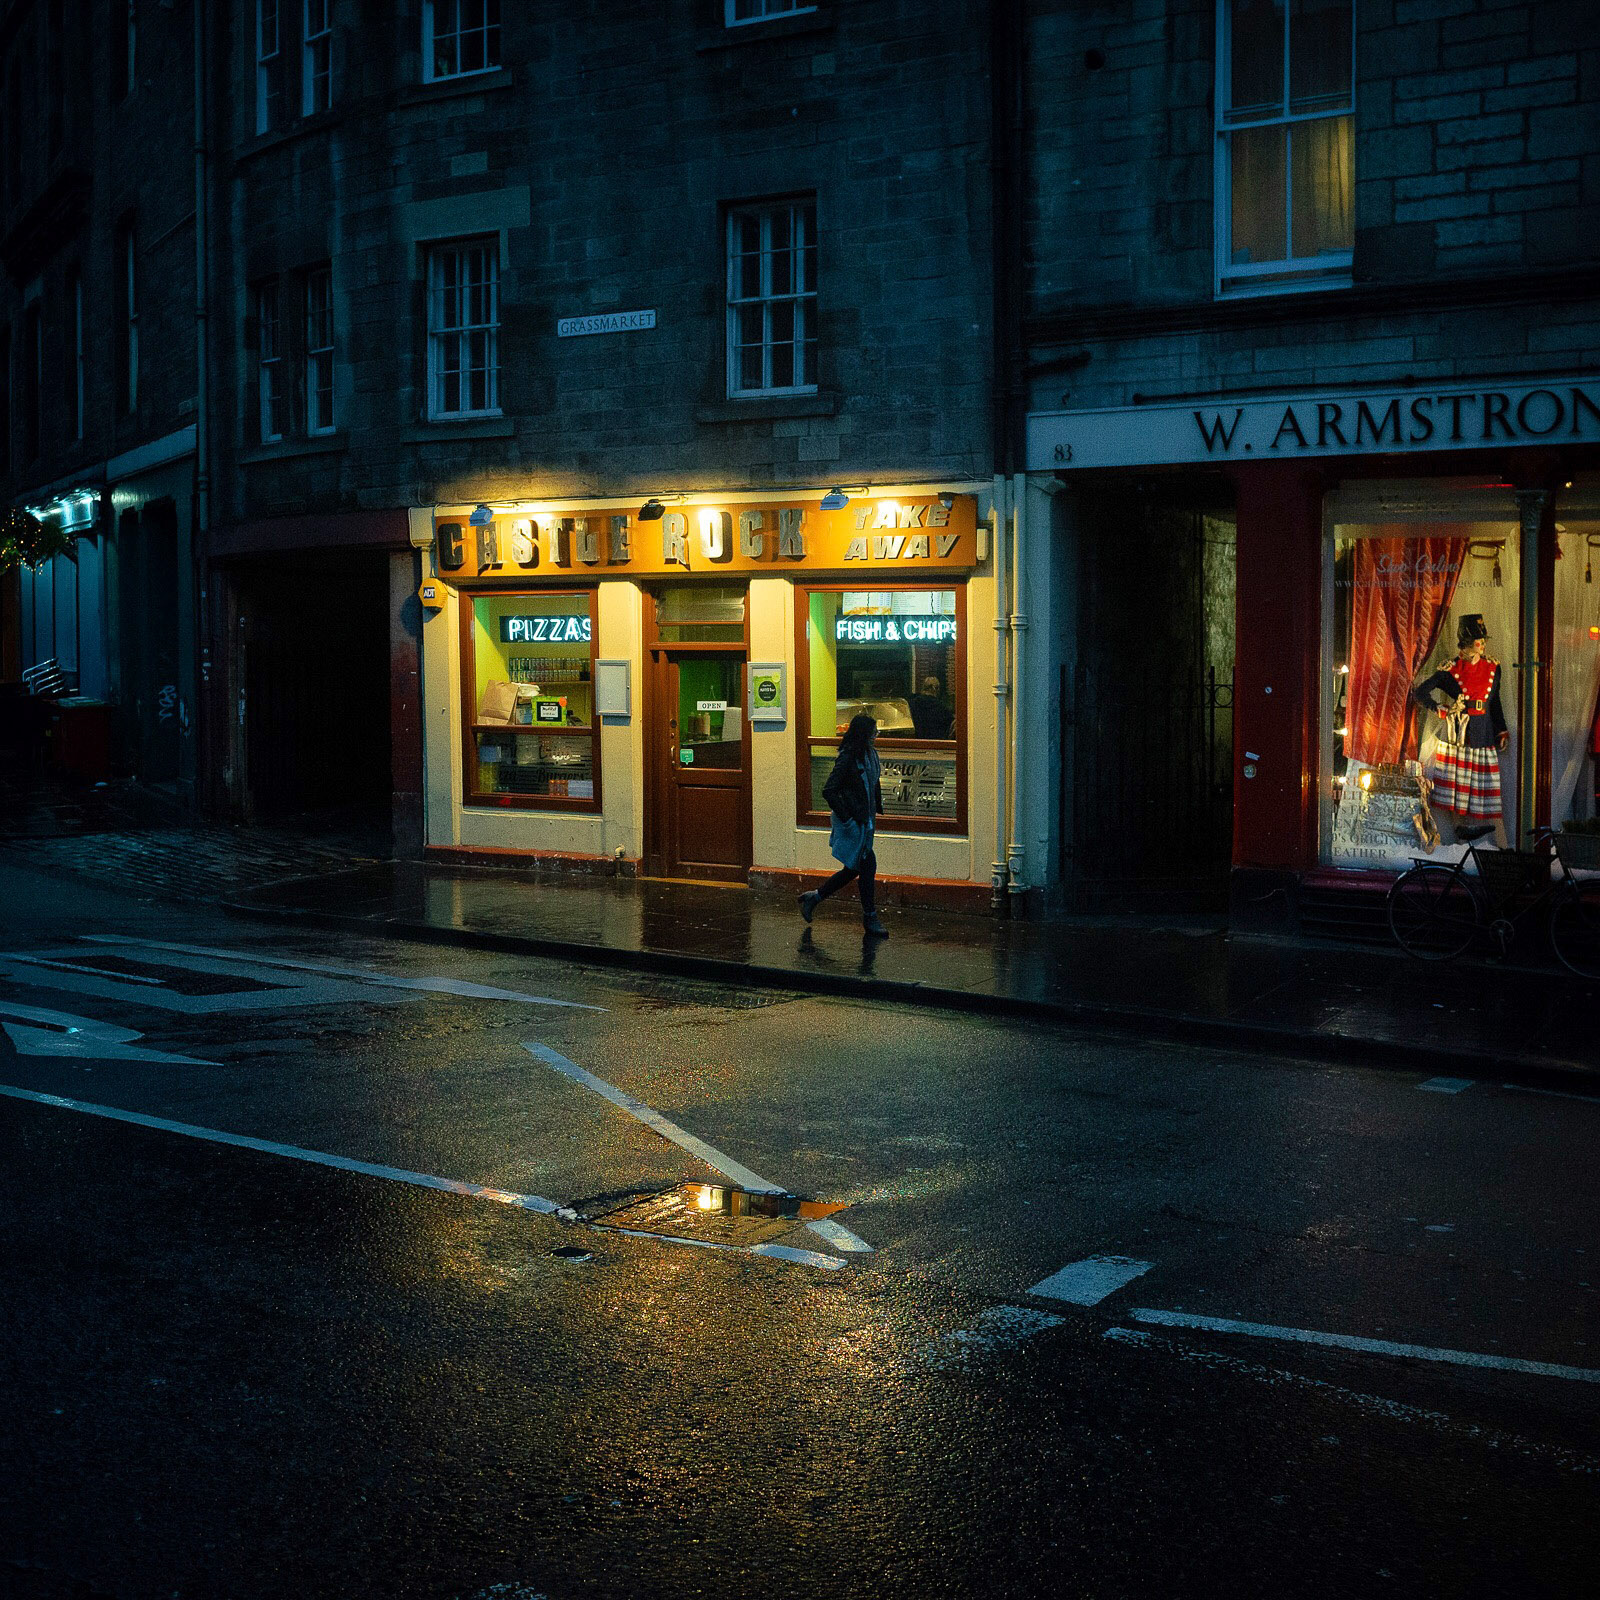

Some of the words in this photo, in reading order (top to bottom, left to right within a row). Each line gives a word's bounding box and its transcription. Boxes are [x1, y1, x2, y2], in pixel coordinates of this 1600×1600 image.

[560, 313, 654, 334] GRASSMARKET
[1193, 408, 1252, 452] W.
[1053, 443, 1074, 463] 83
[853, 502, 952, 530] TAKE
[438, 514, 632, 574] CASTLE
[662, 507, 805, 568] ROCK
[844, 533, 959, 561] AWAY
[424, 588, 435, 598] ADT
[508, 617, 592, 641] PIZZAS
[836, 620, 881, 640] FISH
[885, 621, 901, 641] &
[1326, 847, 1387, 859] EATHER
